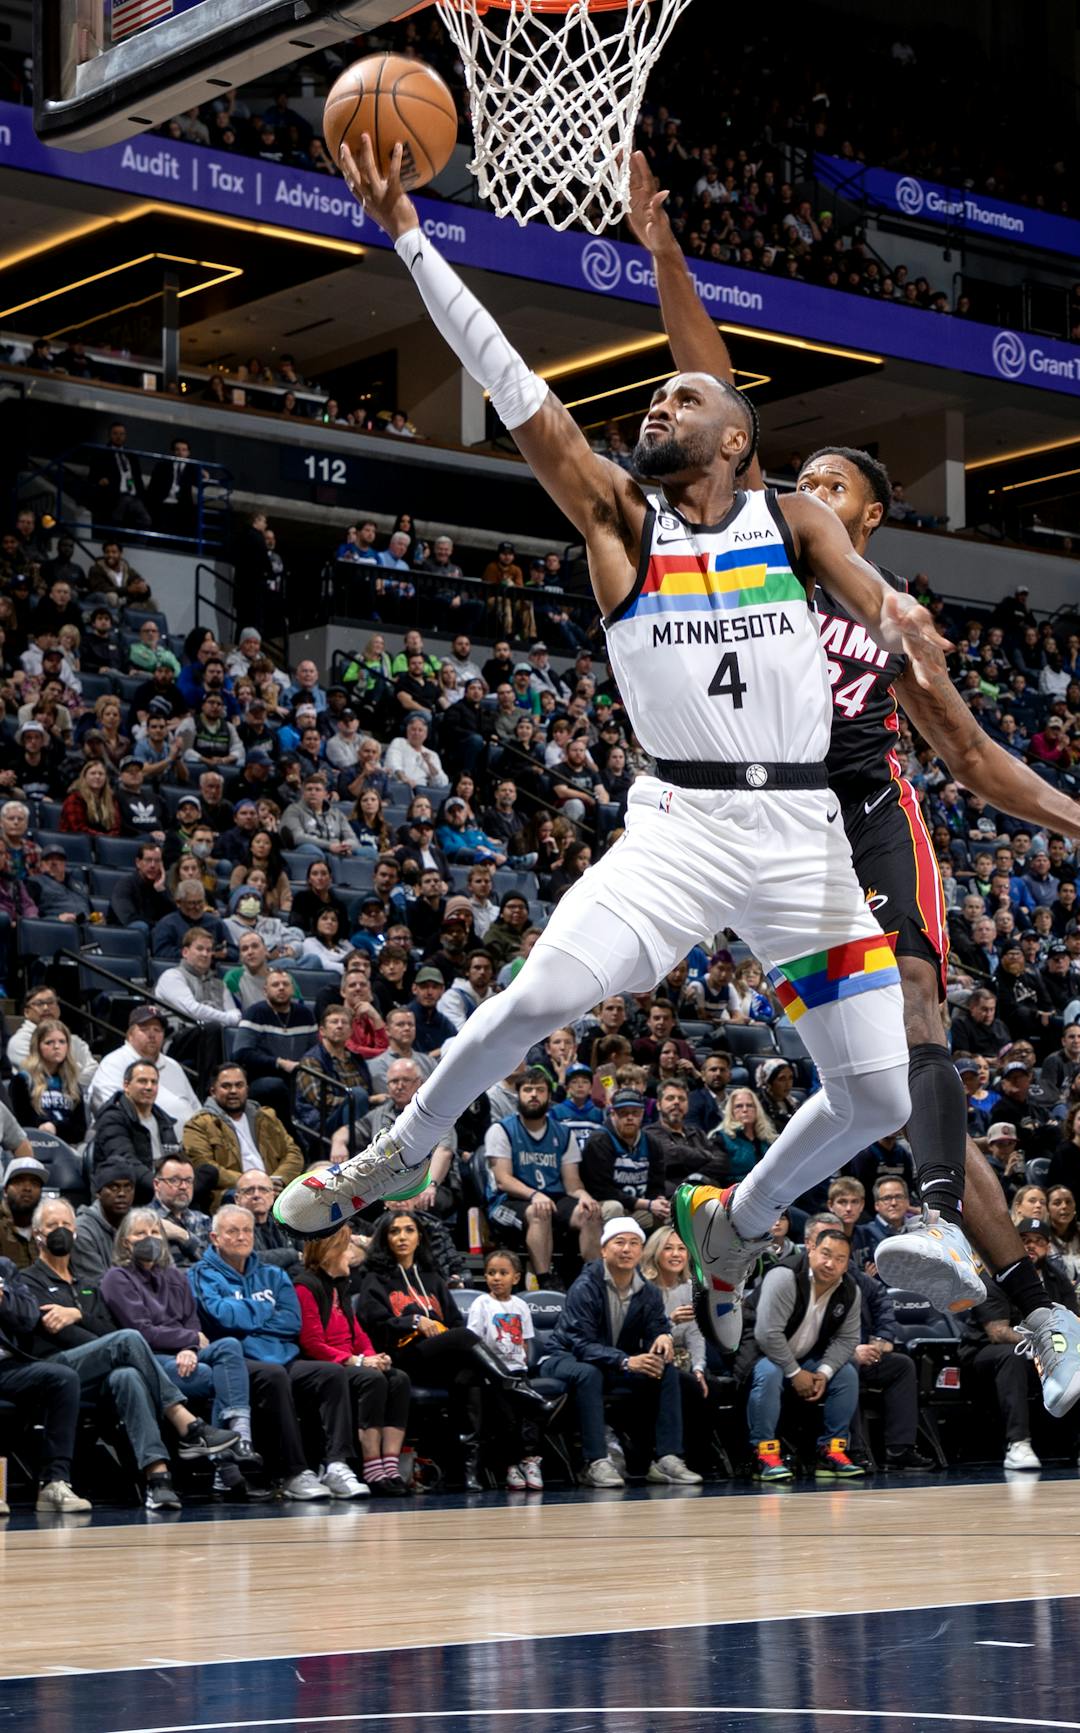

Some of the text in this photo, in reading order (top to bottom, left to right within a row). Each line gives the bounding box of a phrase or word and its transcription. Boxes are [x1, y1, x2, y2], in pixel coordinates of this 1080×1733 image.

[121, 145, 180, 180] Audit
[208, 163, 244, 194] Tax
[275, 179, 365, 227] Advisory
[304, 455, 347, 484] 112
[652, 611, 795, 648] MINNESOTA
[707, 651, 747, 709] 4
[535, 1169, 546, 1190] 9
